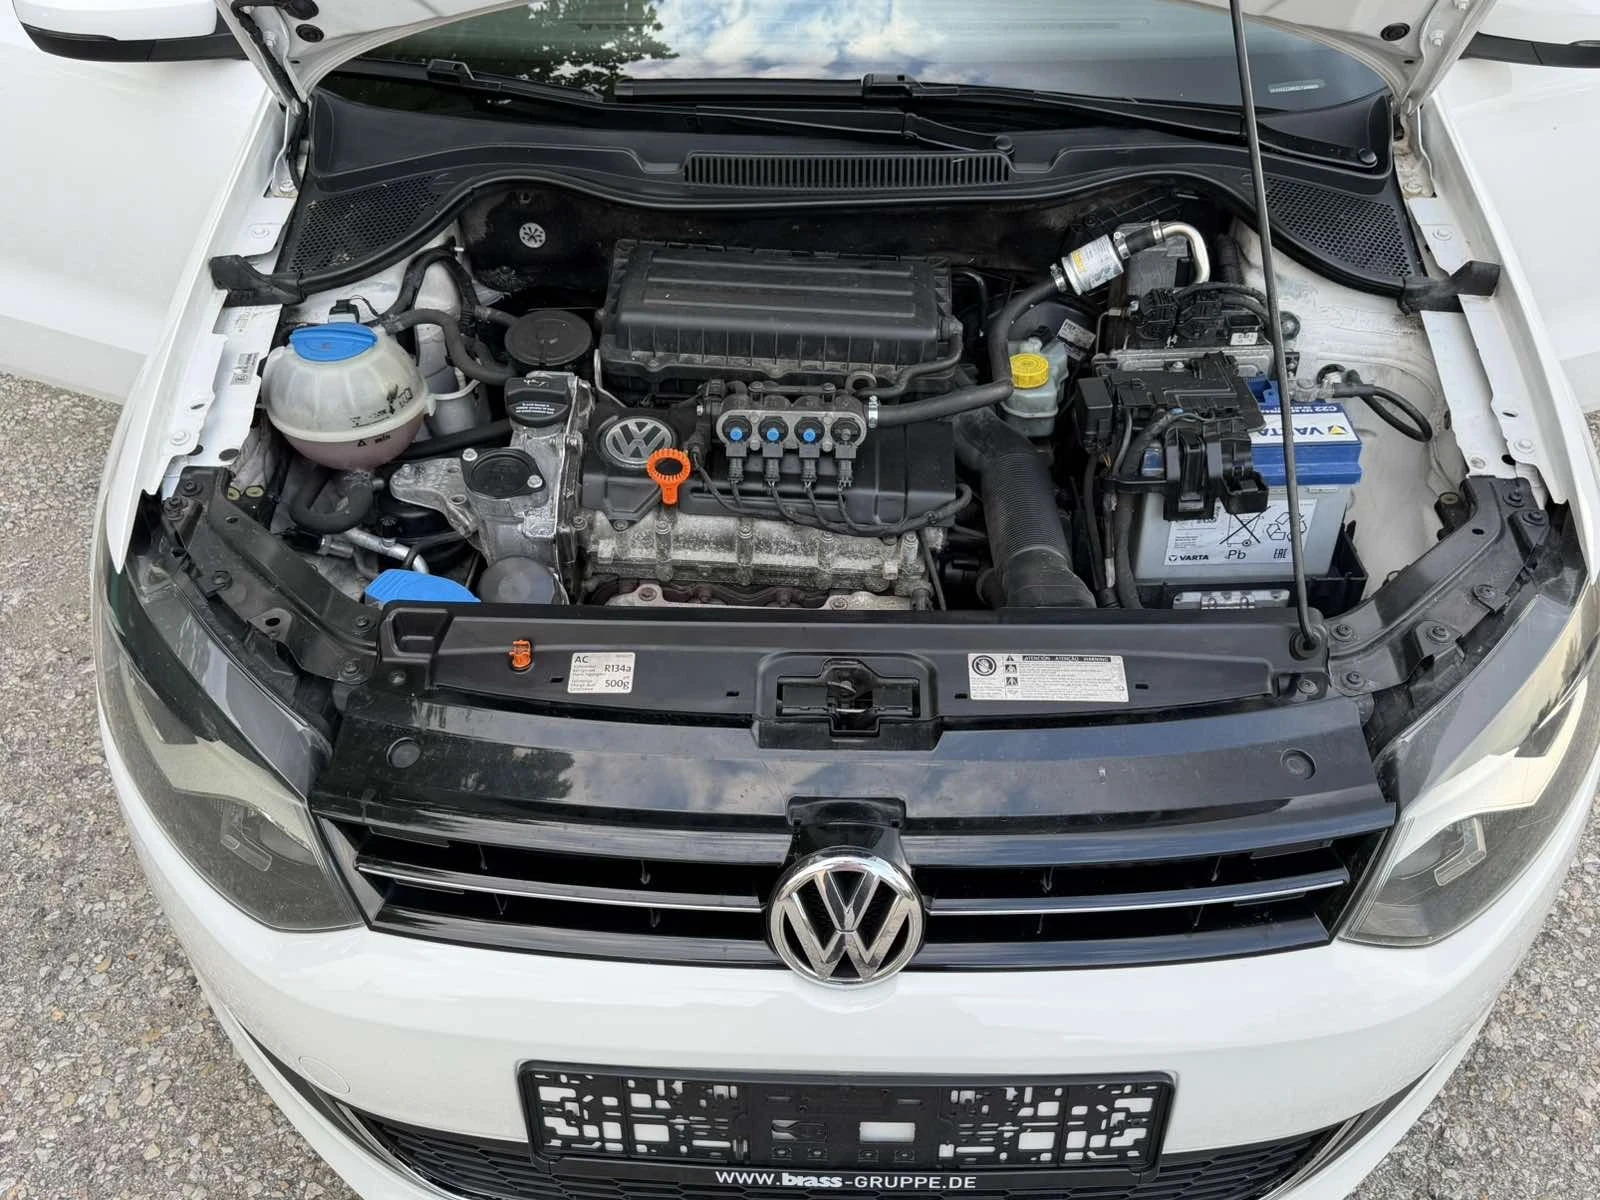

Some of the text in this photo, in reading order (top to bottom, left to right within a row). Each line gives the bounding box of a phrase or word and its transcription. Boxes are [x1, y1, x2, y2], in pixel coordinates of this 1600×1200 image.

[1258, 427, 1325, 436] VATA
[605, 417, 673, 465] VW
[1227, 550, 1246, 560] Pb
[574, 655, 589, 664] AC
[604, 664, 632, 673] R134a
[604, 680, 630, 690] 500g
[771, 856, 923, 990] VW
[715, 1171, 977, 1189] WWW.brass-GRUPPE.DE
